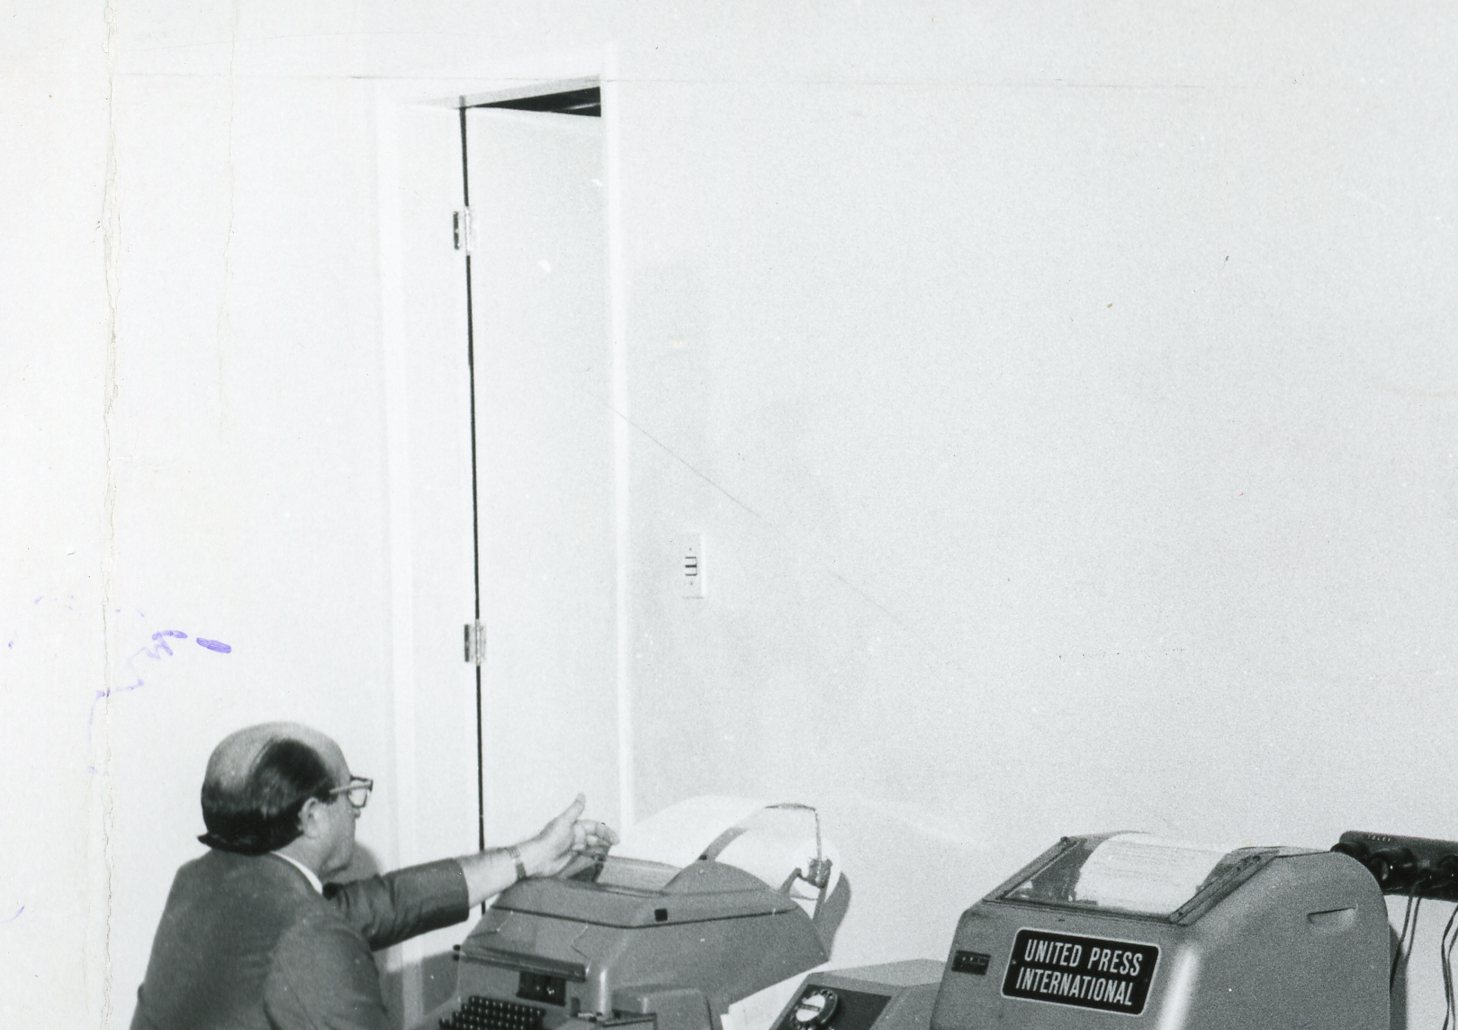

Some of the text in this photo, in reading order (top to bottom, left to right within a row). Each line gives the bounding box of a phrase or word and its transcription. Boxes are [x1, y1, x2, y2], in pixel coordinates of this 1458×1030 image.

[1024, 938, 1082, 968] UNITED
[1087, 947, 1143, 977] PRESS
[1015, 966, 1134, 1006] INTERNATIONAL
